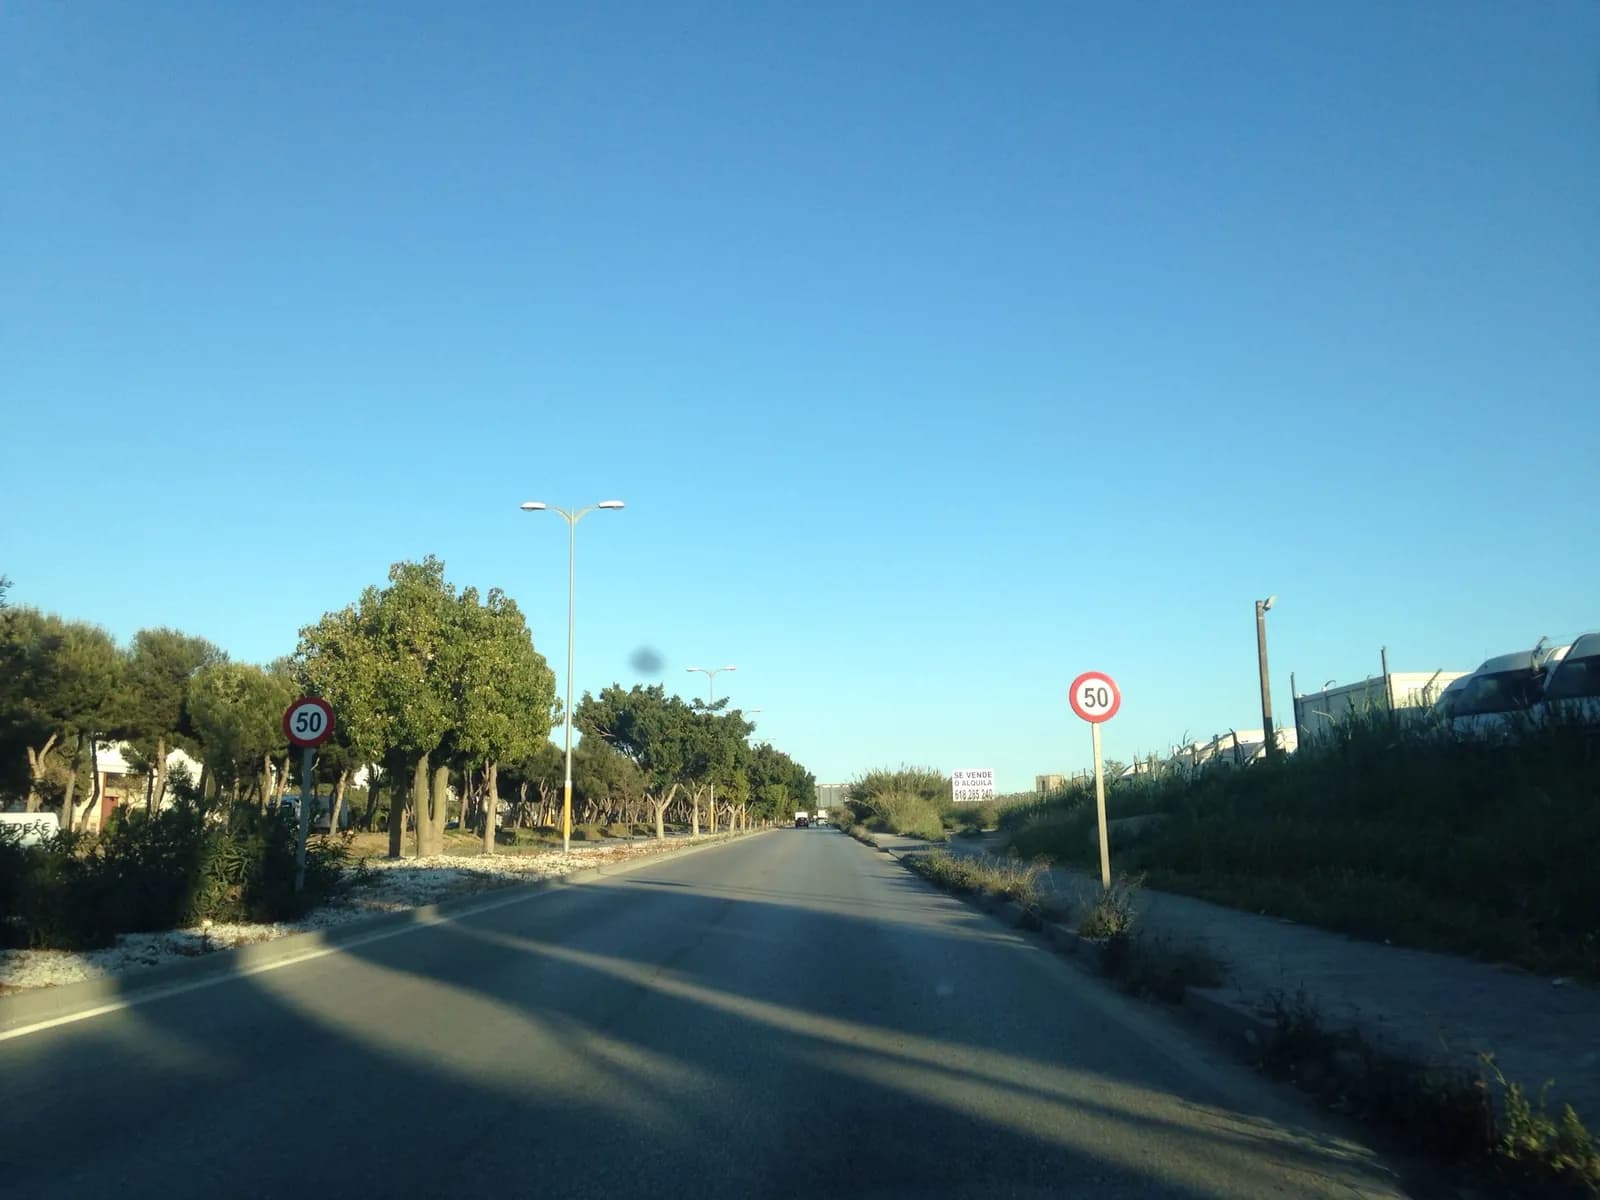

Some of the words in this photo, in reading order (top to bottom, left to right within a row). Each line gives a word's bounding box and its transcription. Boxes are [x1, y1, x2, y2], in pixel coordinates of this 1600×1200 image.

[1084, 687, 1108, 708] 50
[296, 712, 321, 732] 50
[966, 771, 992, 779] VENDE
